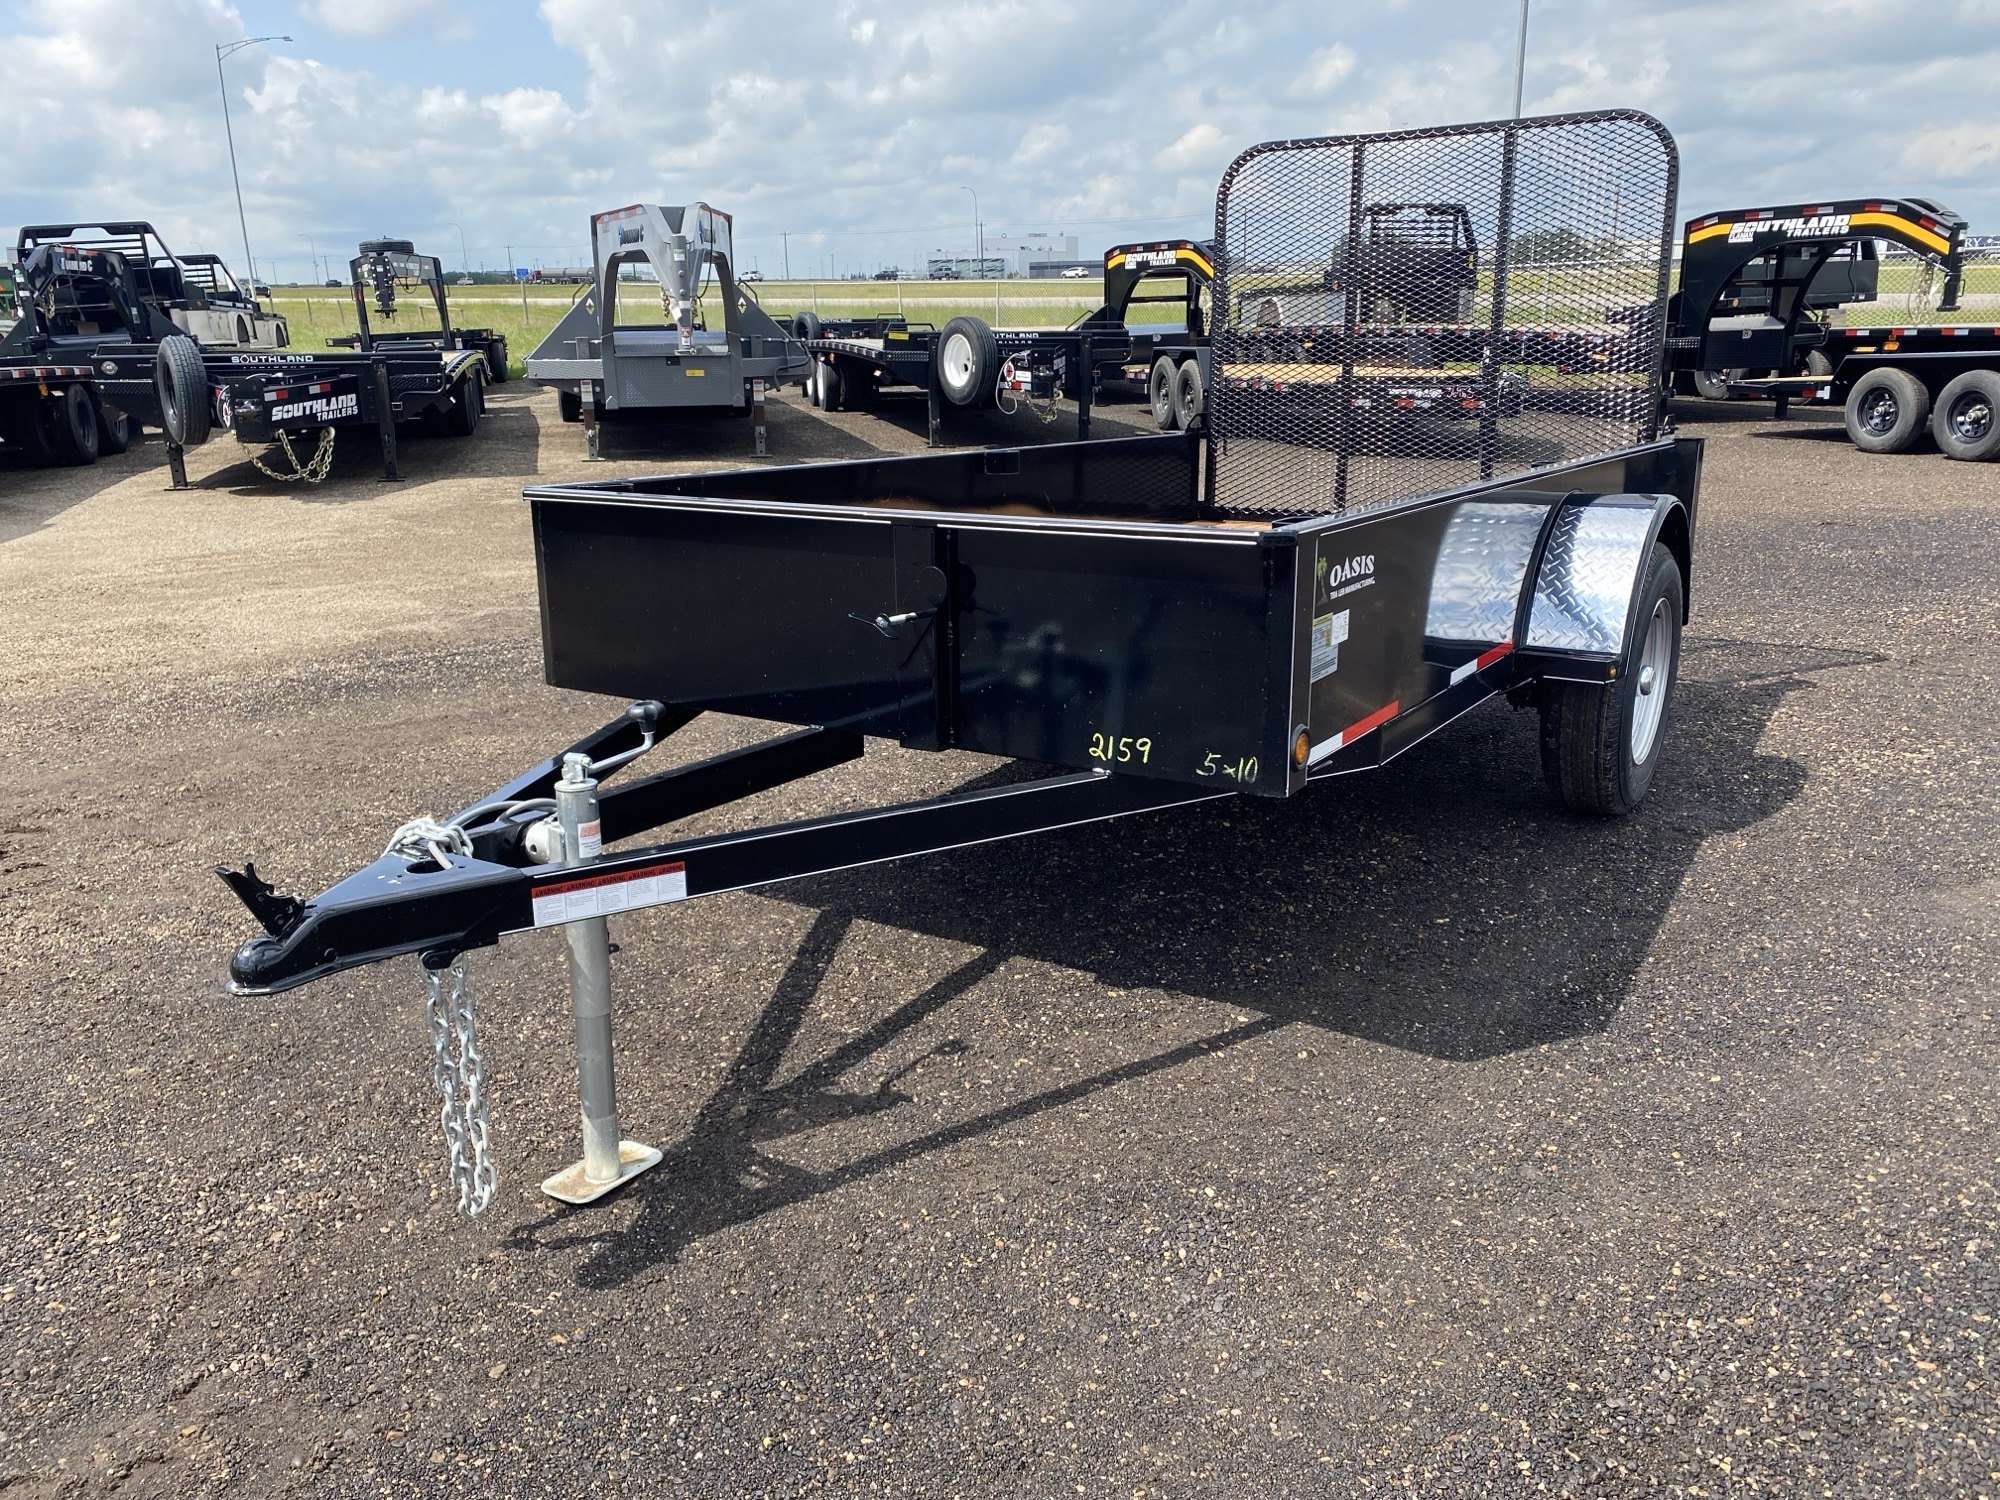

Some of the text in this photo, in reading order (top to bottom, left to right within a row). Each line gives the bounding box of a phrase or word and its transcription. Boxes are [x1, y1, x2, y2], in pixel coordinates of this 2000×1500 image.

[1730, 215, 1850, 234] SOUTHLAND
[1786, 225, 1849, 238] TRAILERS
[231, 354, 314, 364] SOUTHLAND
[271, 393, 357, 422] SOUTHLAND
[316, 405, 358, 422] TRAILERS
[1330, 554, 1375, 587] OASIS
[1088, 732, 1152, 764] 2159
[1196, 752, 1259, 784] 5x10
